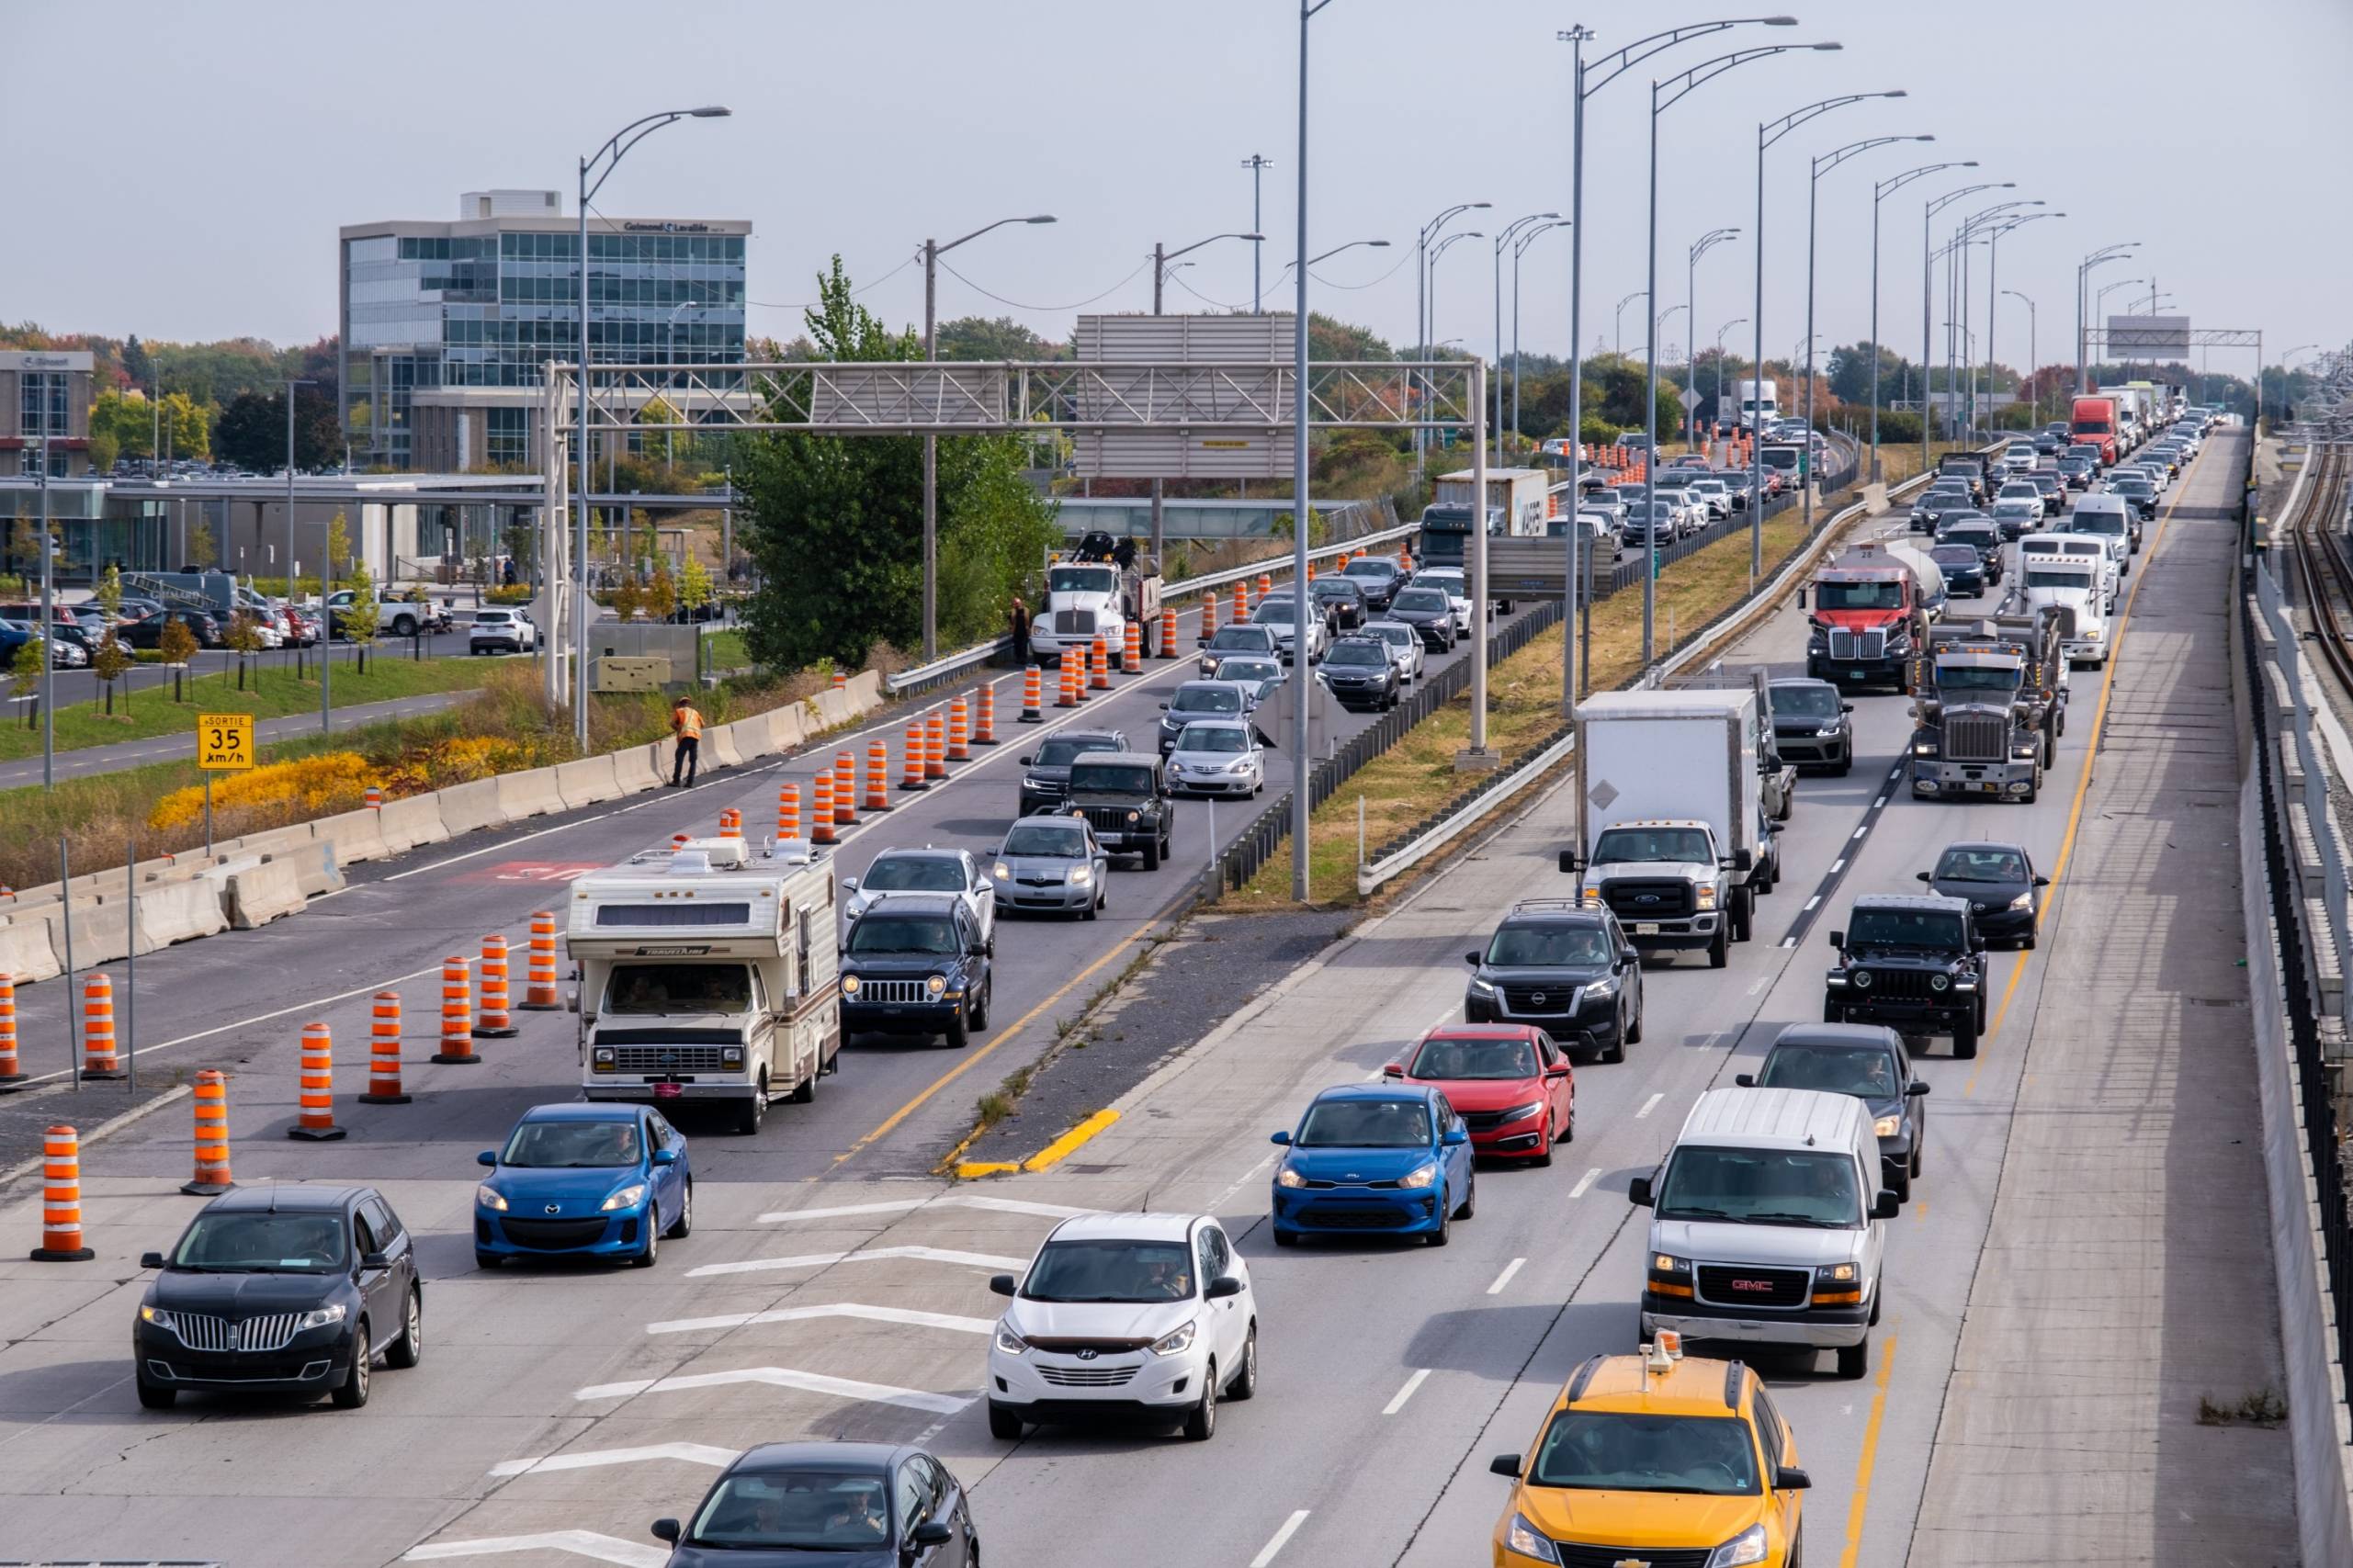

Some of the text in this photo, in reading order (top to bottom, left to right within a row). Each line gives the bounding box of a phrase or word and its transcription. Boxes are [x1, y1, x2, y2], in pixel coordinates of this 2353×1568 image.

[209, 716, 244, 726] SORTIE
[209, 728, 240, 750] 35
[207, 752, 244, 762] km/h
[1732, 1280, 1773, 1292] GMC
